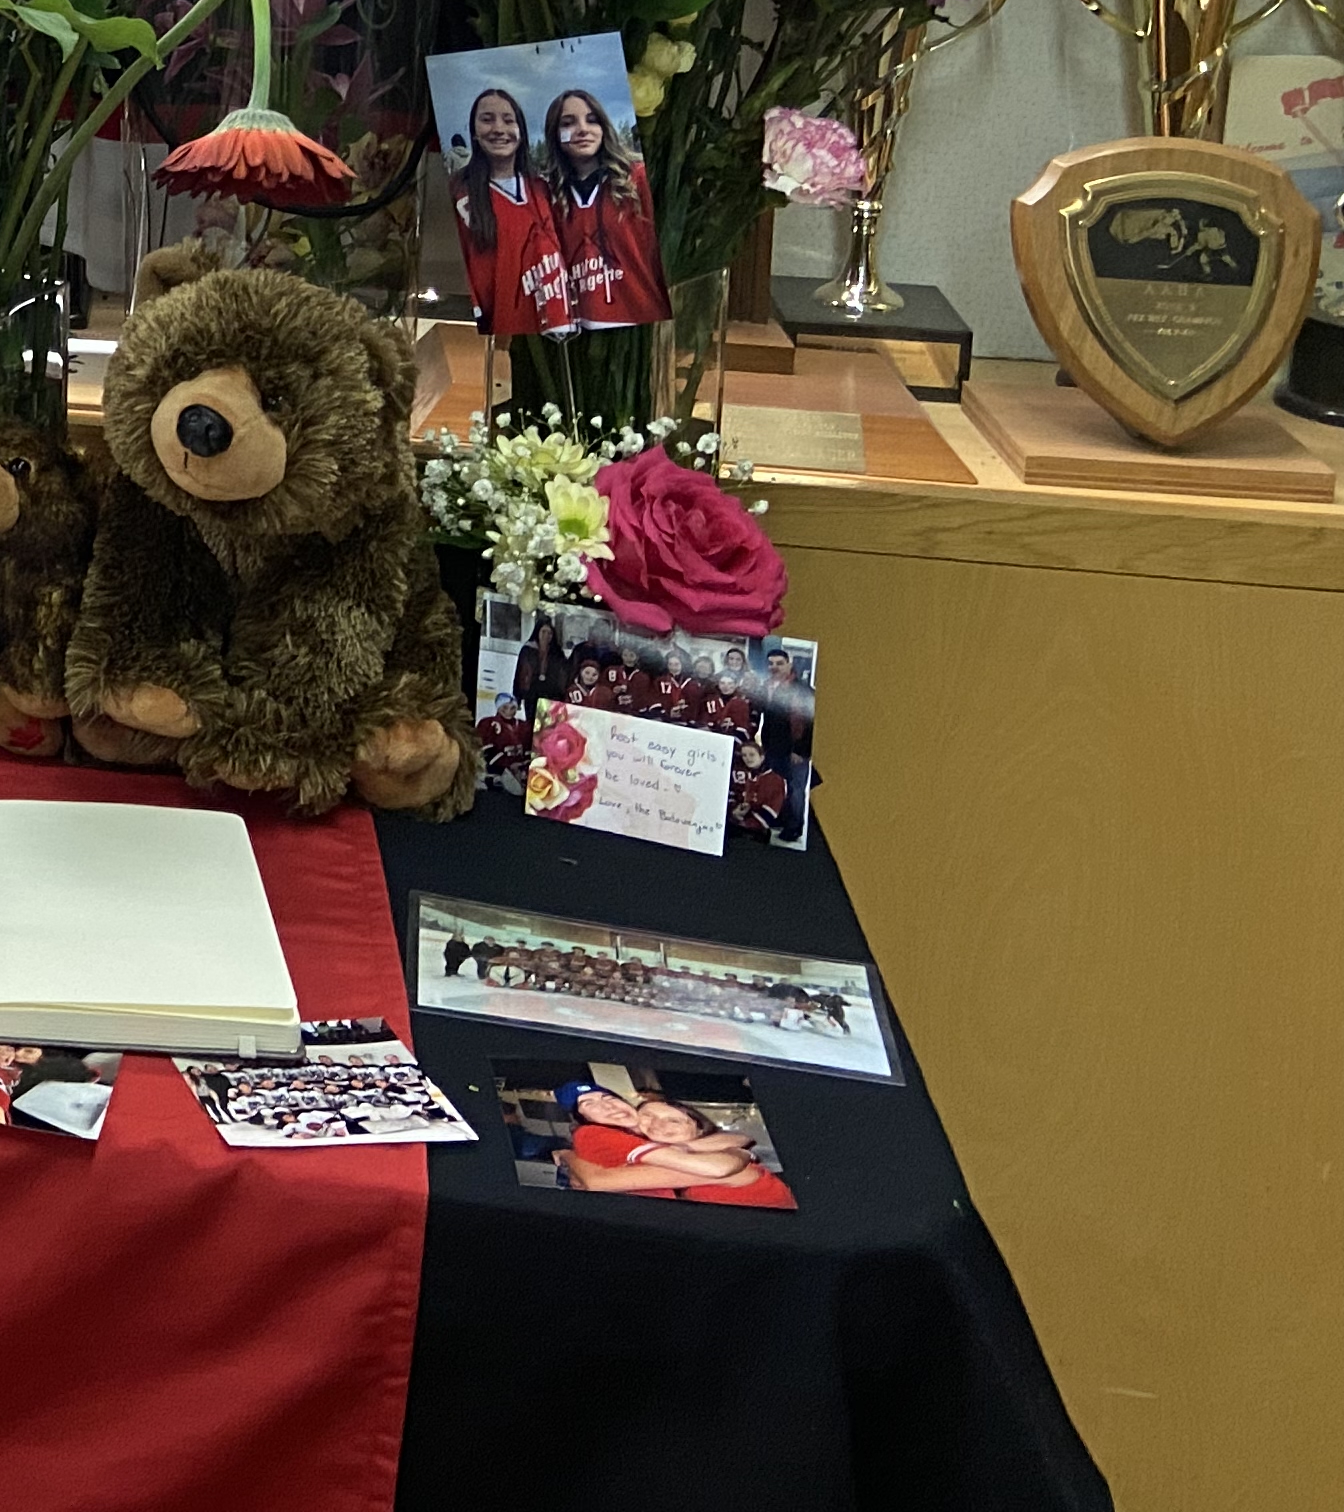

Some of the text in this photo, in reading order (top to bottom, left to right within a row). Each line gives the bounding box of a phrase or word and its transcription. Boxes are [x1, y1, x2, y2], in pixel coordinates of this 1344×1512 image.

[606, 749, 625, 761] you
[605, 769, 619, 783] be
[634, 802, 651, 816] the
